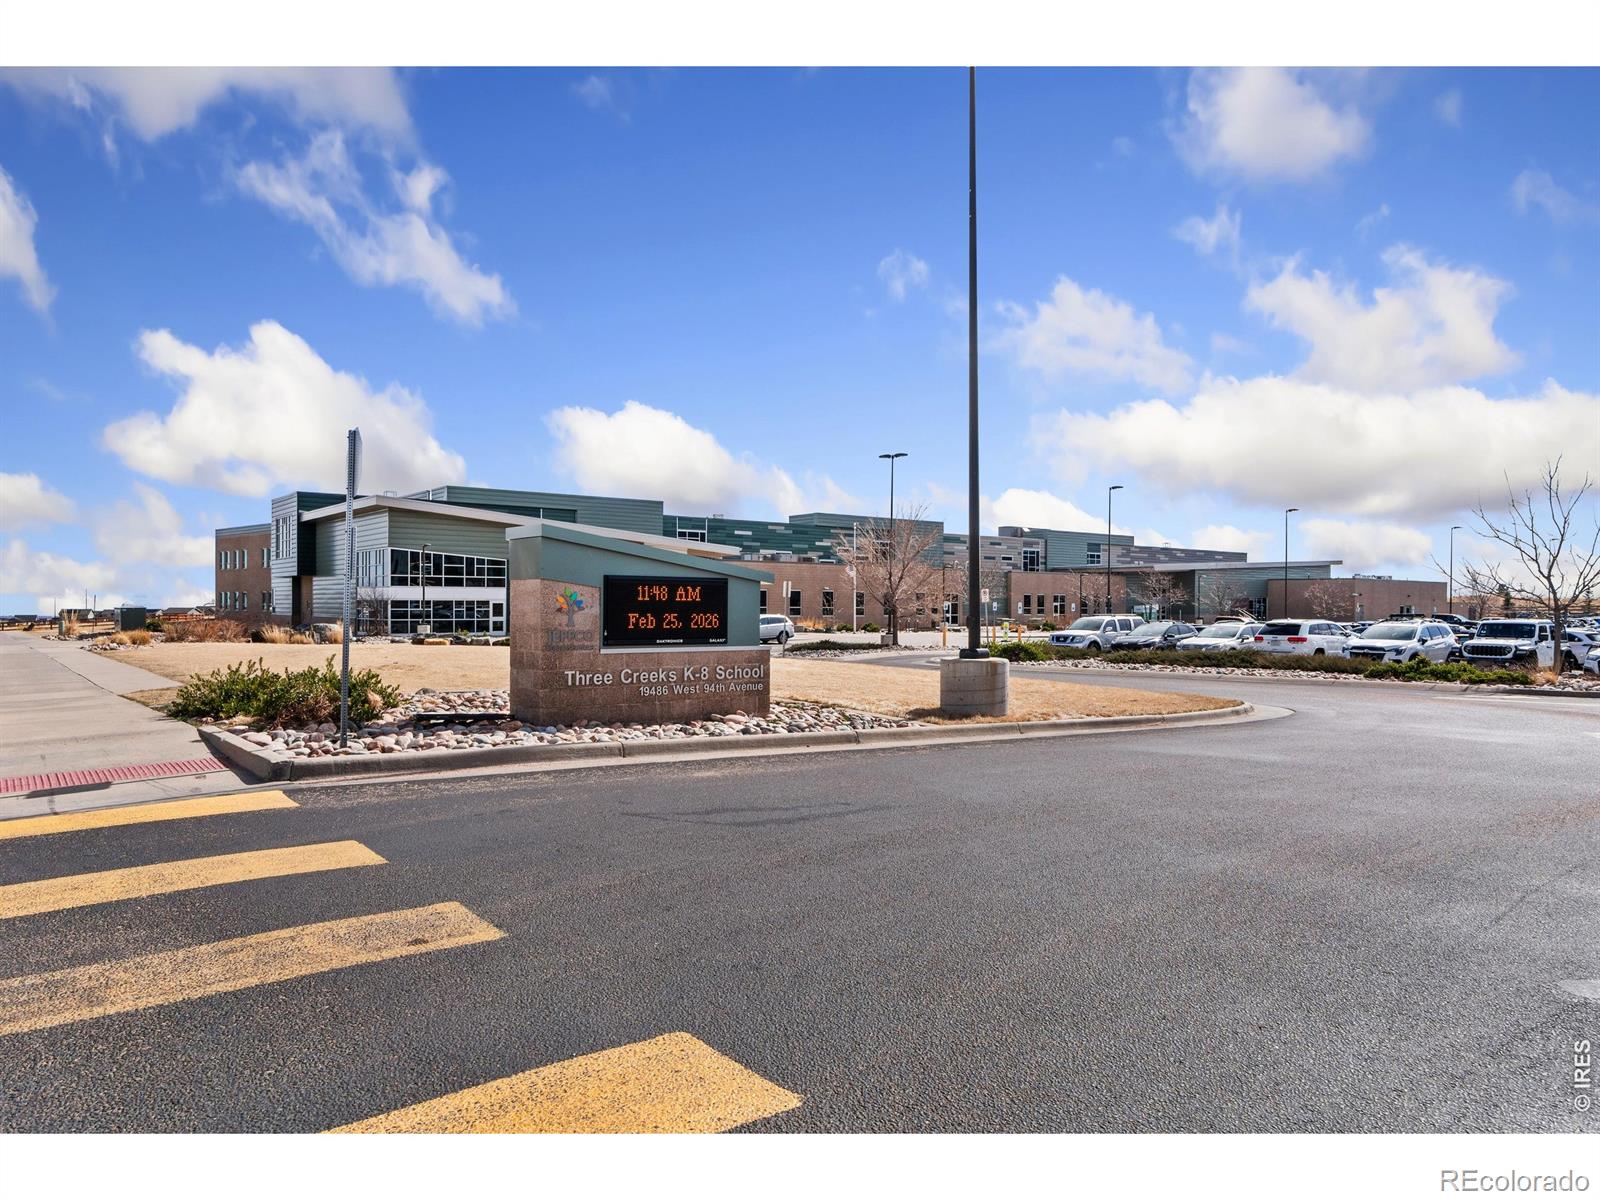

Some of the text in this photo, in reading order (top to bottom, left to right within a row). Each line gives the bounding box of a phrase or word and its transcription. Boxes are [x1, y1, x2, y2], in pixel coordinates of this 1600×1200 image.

[637, 585, 702, 602] 11:48 AM
[628, 613, 719, 629] Feb 25, 2026
[564, 665, 764, 686] Three Creeks K-8 School
[639, 682, 764, 697] 19486 West 94th Avenue
